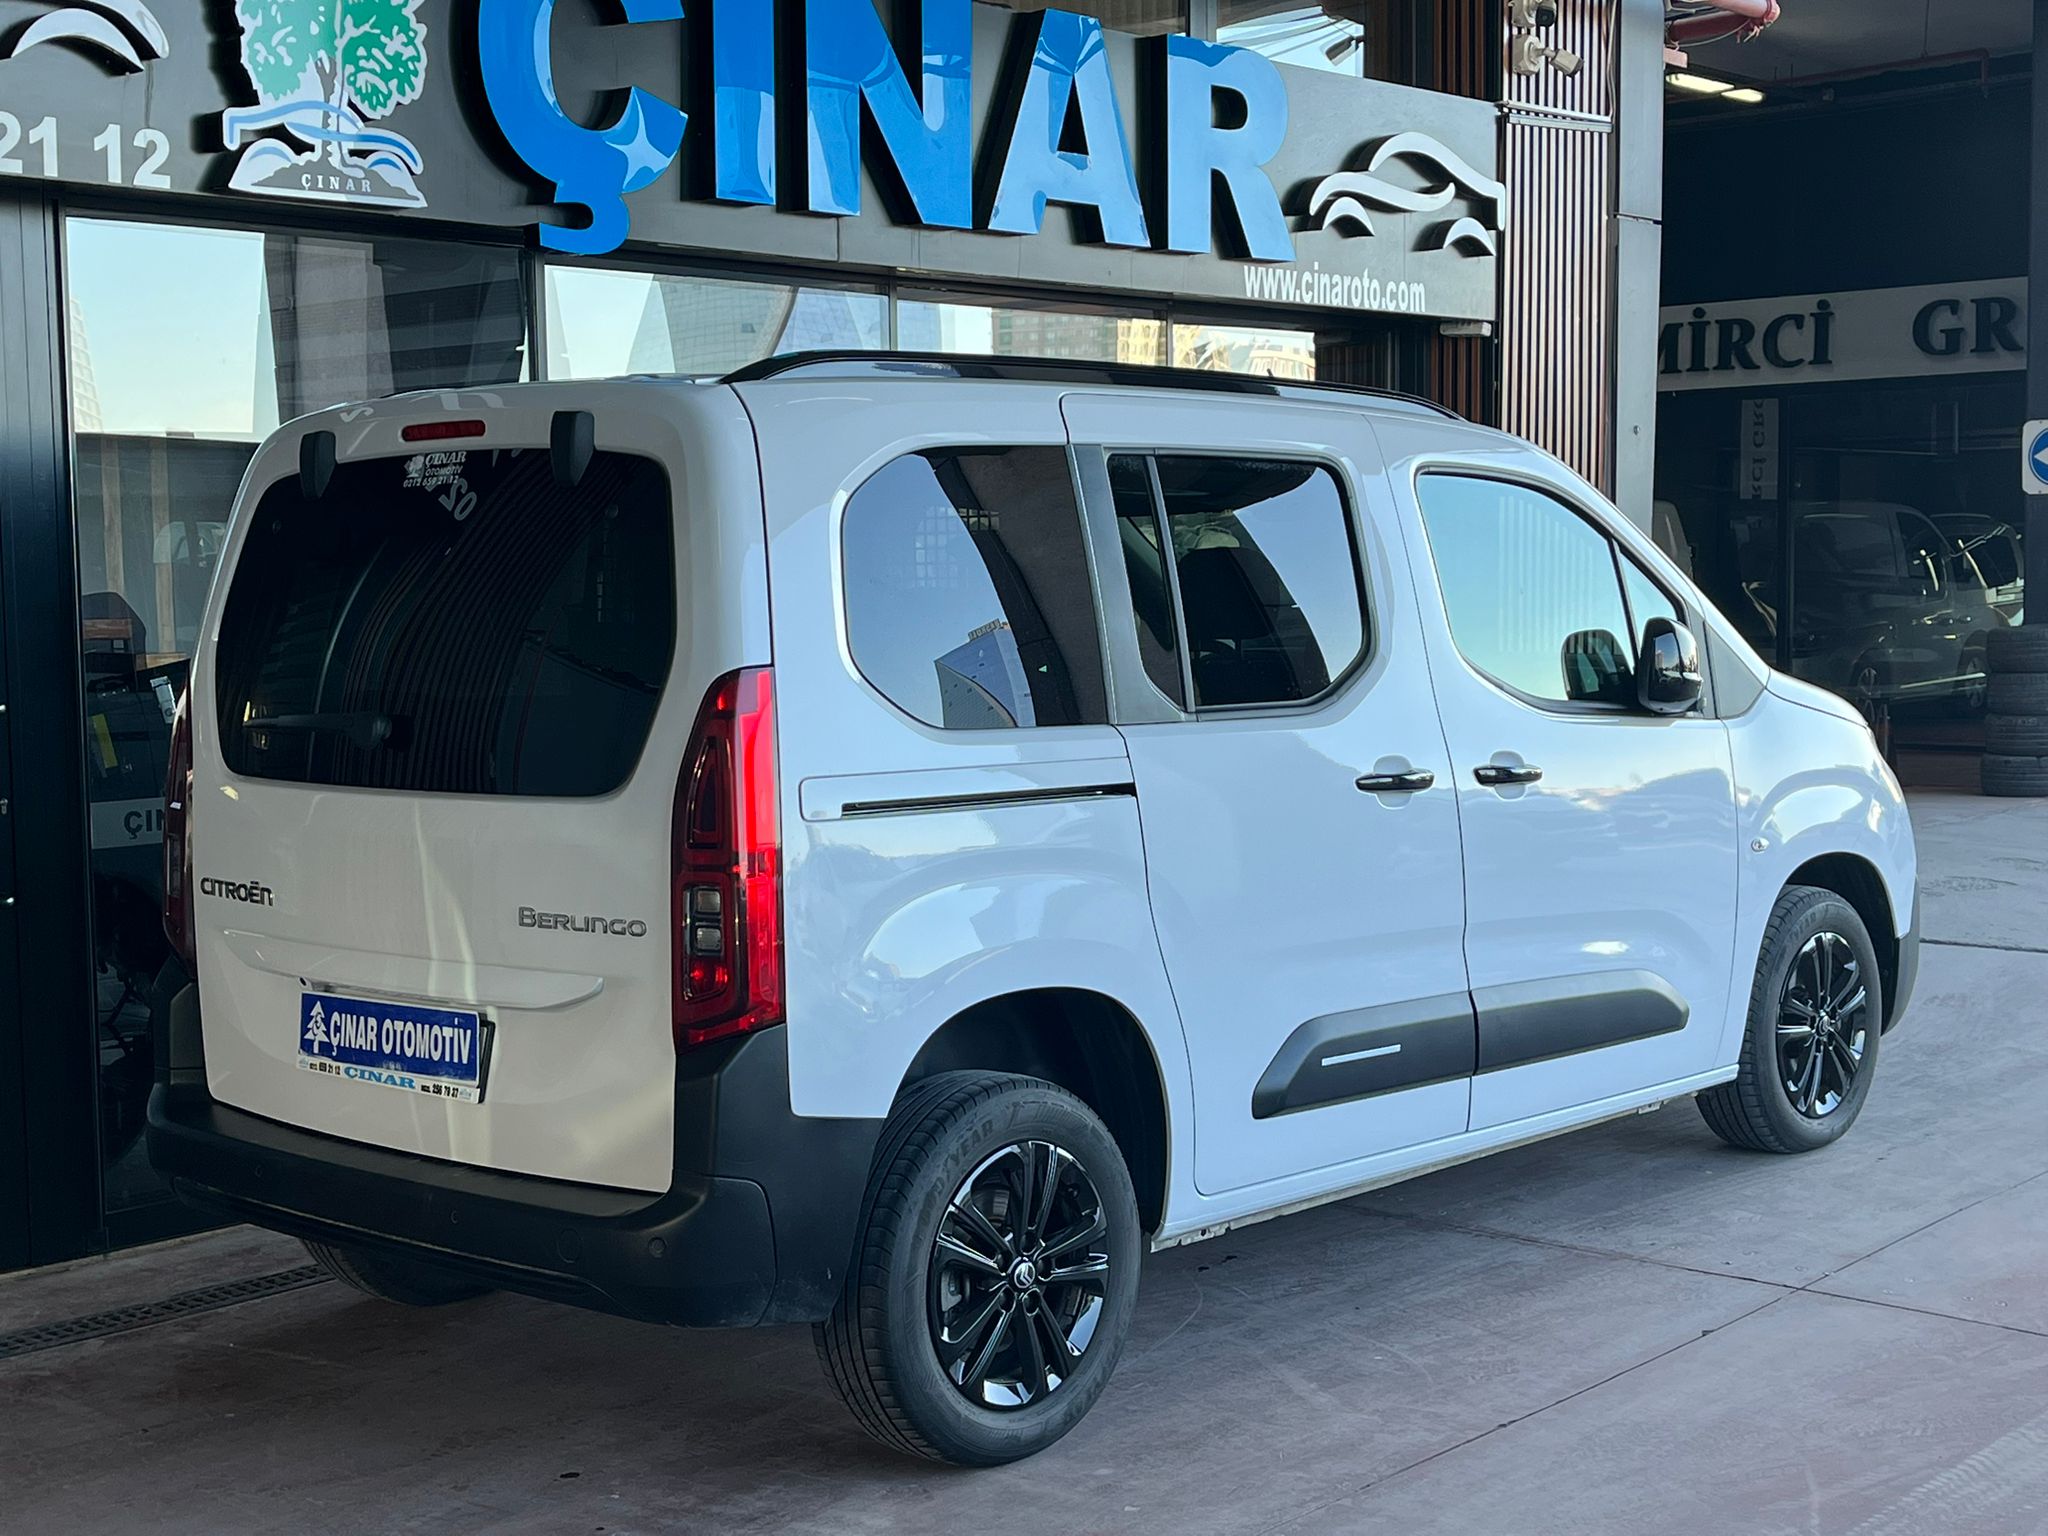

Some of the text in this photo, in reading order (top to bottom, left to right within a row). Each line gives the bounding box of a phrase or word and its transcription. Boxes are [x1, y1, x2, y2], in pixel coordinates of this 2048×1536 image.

[0, 111, 171, 188] 21 12
[479, 0, 1294, 255] ÇINAR
[301, 173, 371, 192] ÇINAR
[1244, 262, 1426, 312] www.cinaroto.com
[425, 451, 467, 469] ÇINAR
[200, 877, 273, 907] CITROËN
[330, 1011, 378, 1056] ÇINAR
[381, 1017, 472, 1065] OTOMOTİV
